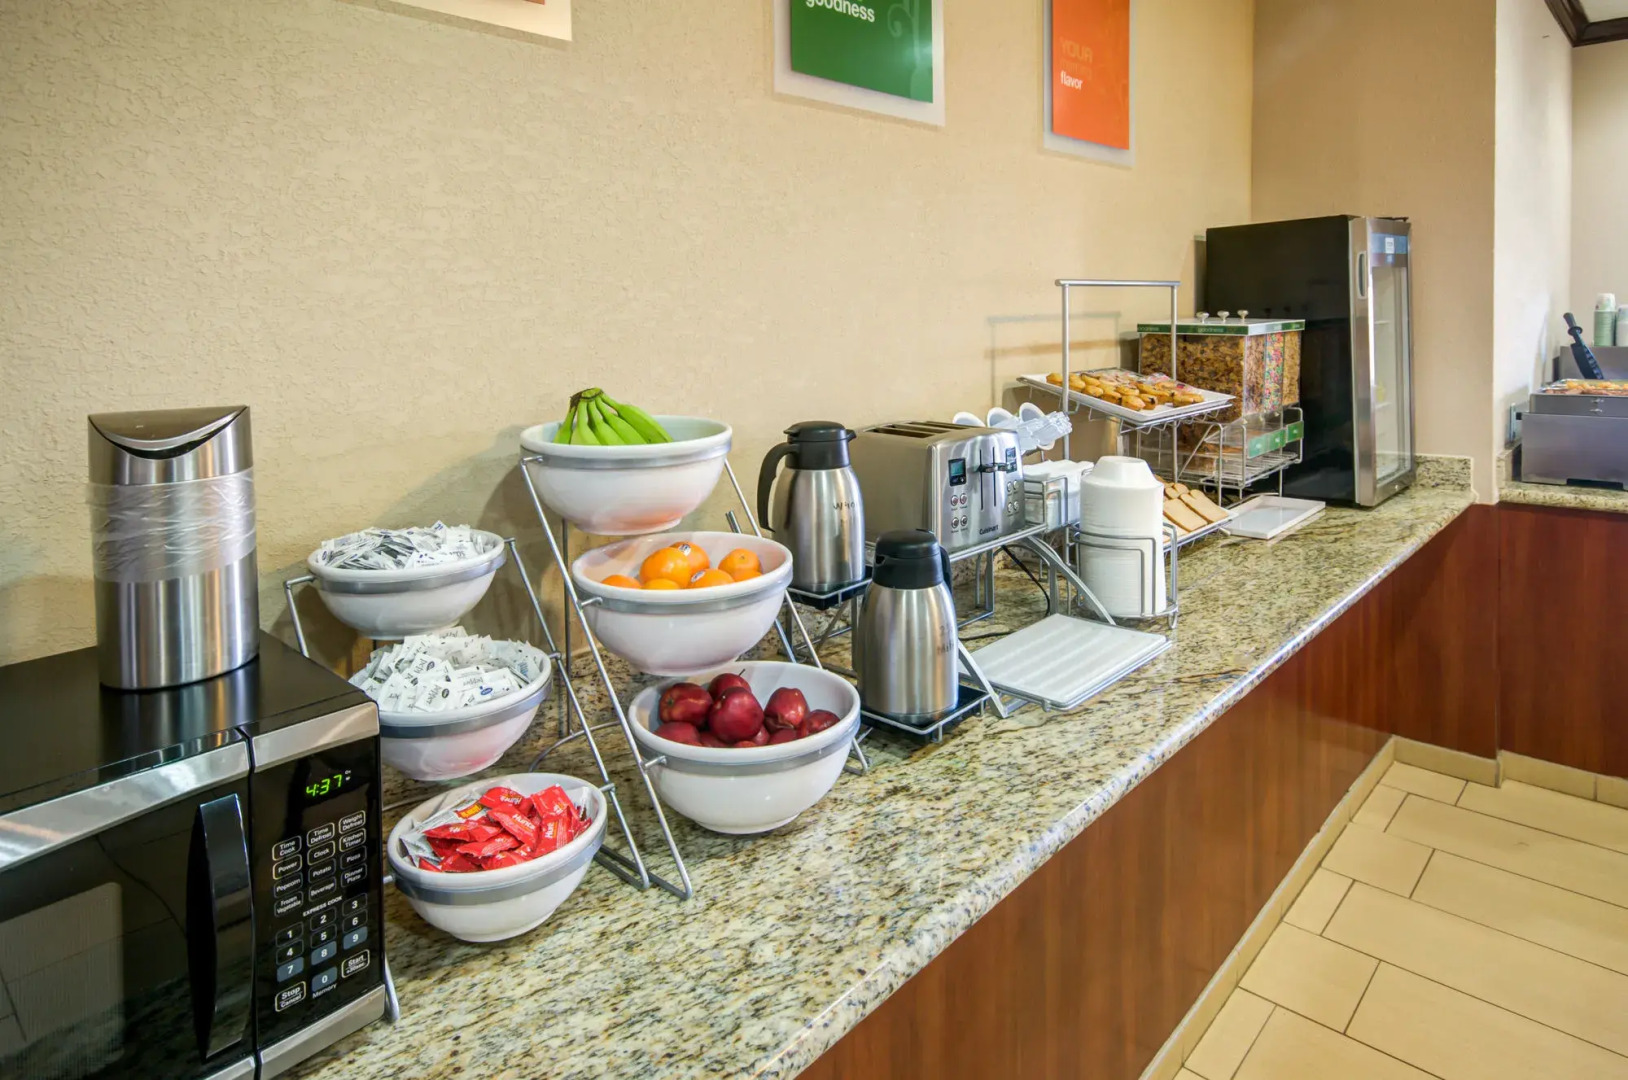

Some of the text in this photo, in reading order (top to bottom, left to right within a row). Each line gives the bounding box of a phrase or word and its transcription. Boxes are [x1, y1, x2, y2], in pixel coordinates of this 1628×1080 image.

[1061, 70, 1083, 90] flavor
[306, 774, 343, 797] 4:37
[342, 819, 363, 831] Defrost
[343, 814, 363, 825] Weight
[310, 832, 332, 844] Defrost
[314, 828, 329, 837] Time
[343, 832, 364, 843] Kitchen
[280, 841, 296, 850] Time
[345, 838, 361, 848] Timer
[313, 848, 330, 859] Clock
[278, 862, 297, 873] Power
[312, 866, 332, 878] Potato
[276, 878, 301, 893] Popcorn
[310, 882, 335, 897] Beverage
[302, 902, 327, 917] EXPRESS
[352, 901, 358, 910] 3
[321, 915, 327, 924] 2
[352, 917, 359, 926] 6
[288, 930, 293, 939] 1
[321, 932, 328, 941] 5
[353, 934, 359, 943] 9
[287, 948, 294, 956] 4
[321, 949, 328, 958] 8
[348, 955, 364, 967] Start
[288, 965, 294, 975] 7
[322, 975, 328, 984] 0
[281, 987, 301, 1000] Stop
[312, 984, 337, 999] Memory
